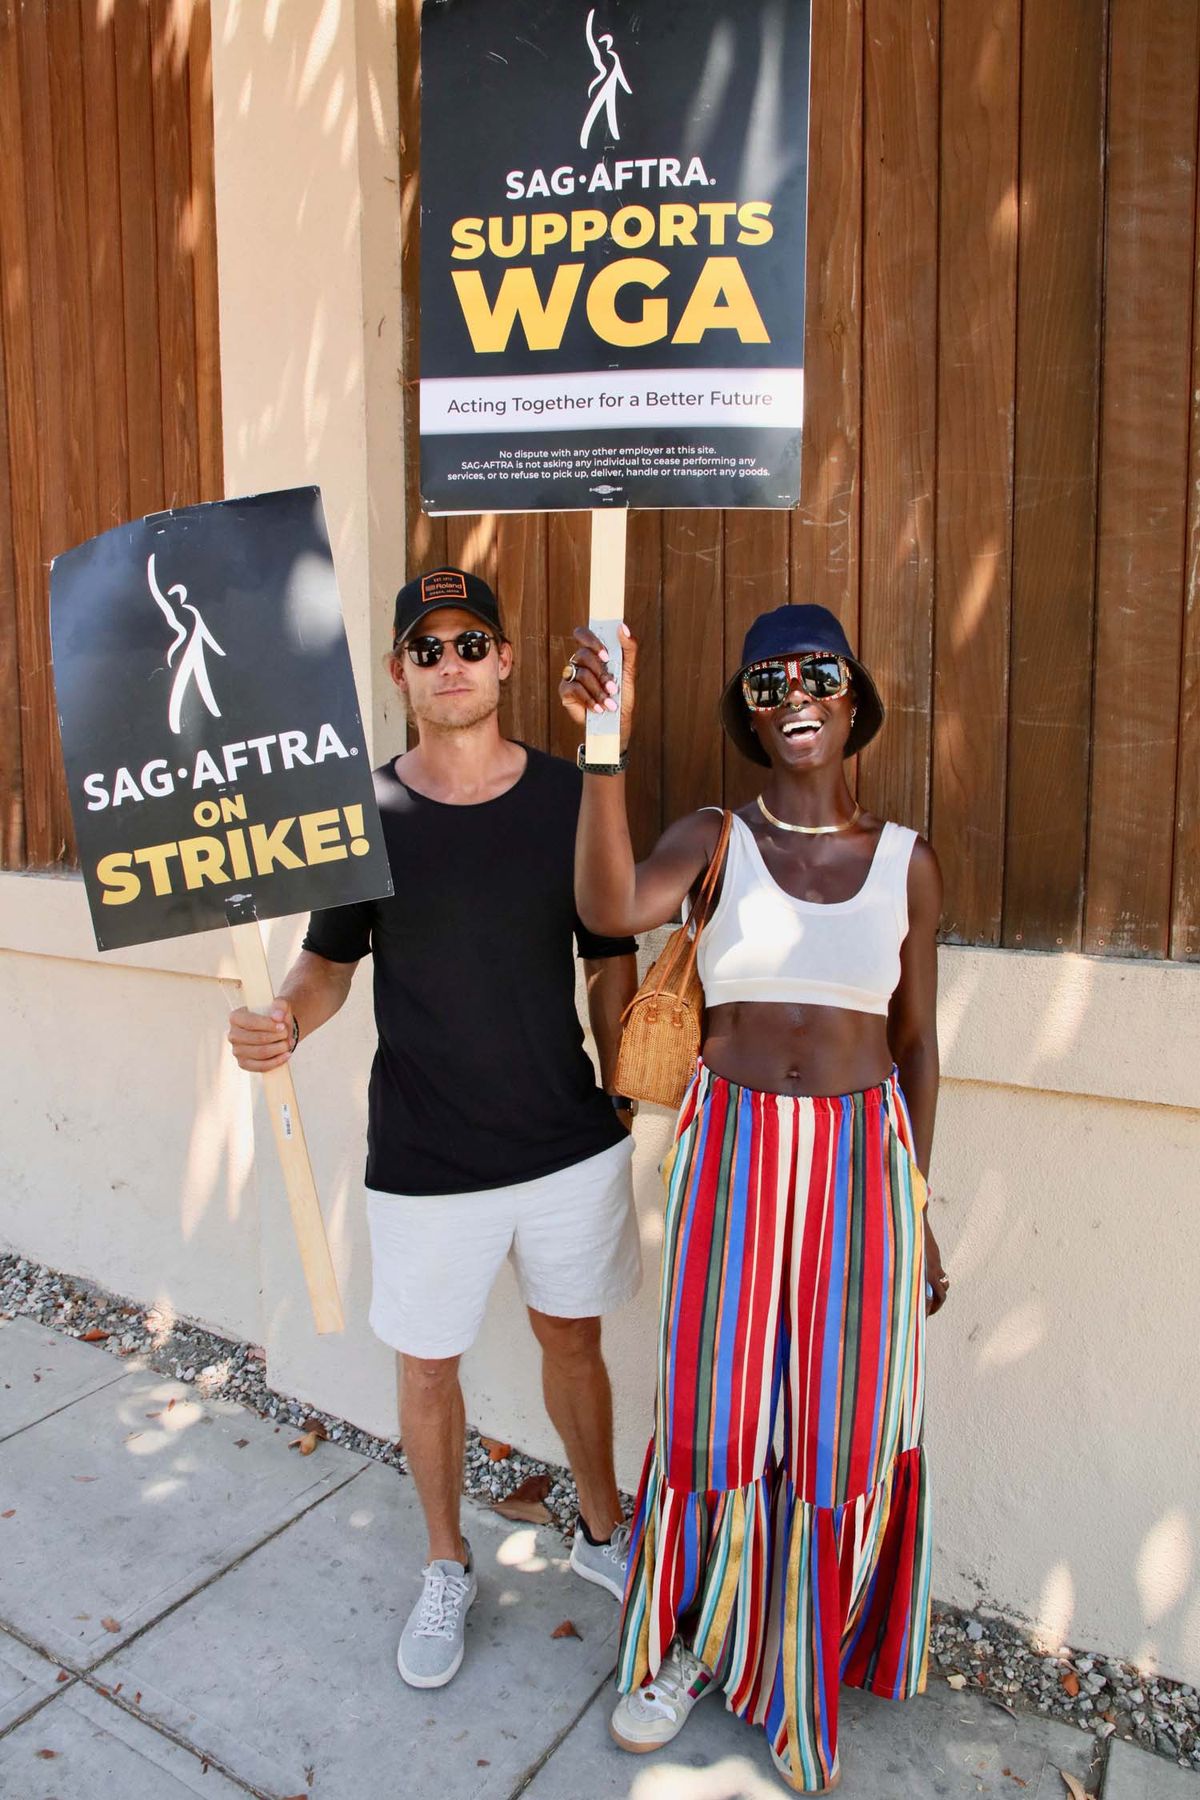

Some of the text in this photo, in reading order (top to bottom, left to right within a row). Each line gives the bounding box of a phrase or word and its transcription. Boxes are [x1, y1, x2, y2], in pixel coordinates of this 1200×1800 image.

[450, 201, 774, 261] SUPPORTS
[450, 256, 771, 353] WGA
[447, 390, 773, 416] Acting Together for a Better Future
[461, 455, 756, 470] SAG-AFTRA is not asking any individual to cease performing any
[499, 445, 717, 460] No dispute with any other employer at this site.
[447, 471, 486, 482] services,
[499, 471, 509, 480] to
[510, 469, 540, 479] refuse
[541, 470, 551, 479] to
[553, 468, 573, 480] pick
[574, 470, 589, 479] up,
[590, 466, 625, 478] deliver,
[626, 465, 659, 477] handle
[660, 468, 670, 476] or
[673, 466, 718, 477] transport
[719, 467, 737, 478] any
[738, 466, 771, 478] goods.
[193, 793, 248, 828] ON
[96, 804, 371, 906] STRIKE!
